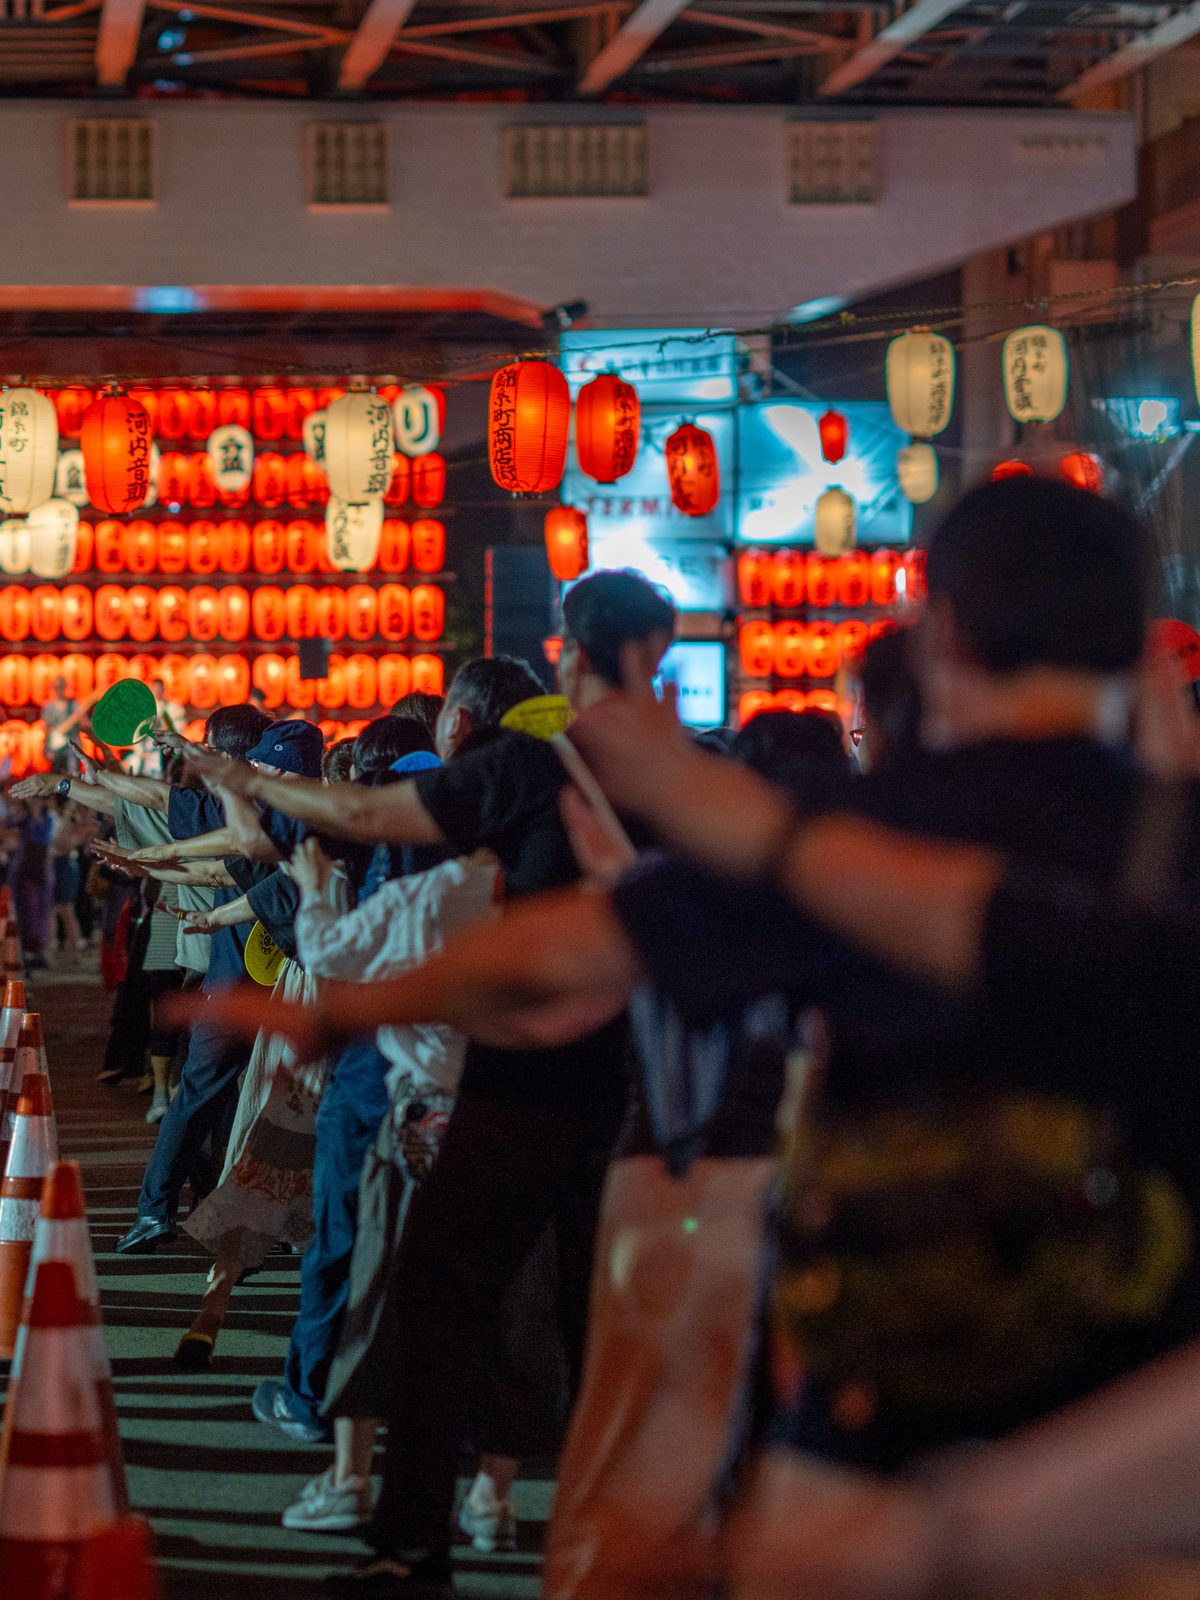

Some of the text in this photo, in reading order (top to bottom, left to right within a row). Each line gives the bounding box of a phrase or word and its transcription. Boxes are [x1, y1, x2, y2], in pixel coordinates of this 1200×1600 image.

[9, 400, 29, 453] 錦糸町
[125, 411, 150, 503] 河内音頭
[219, 436, 245, 473] 盆
[404, 400, 430, 442] り
[364, 402, 391, 495] 河内音頭
[493, 367, 522, 490] 錦糸町商店街
